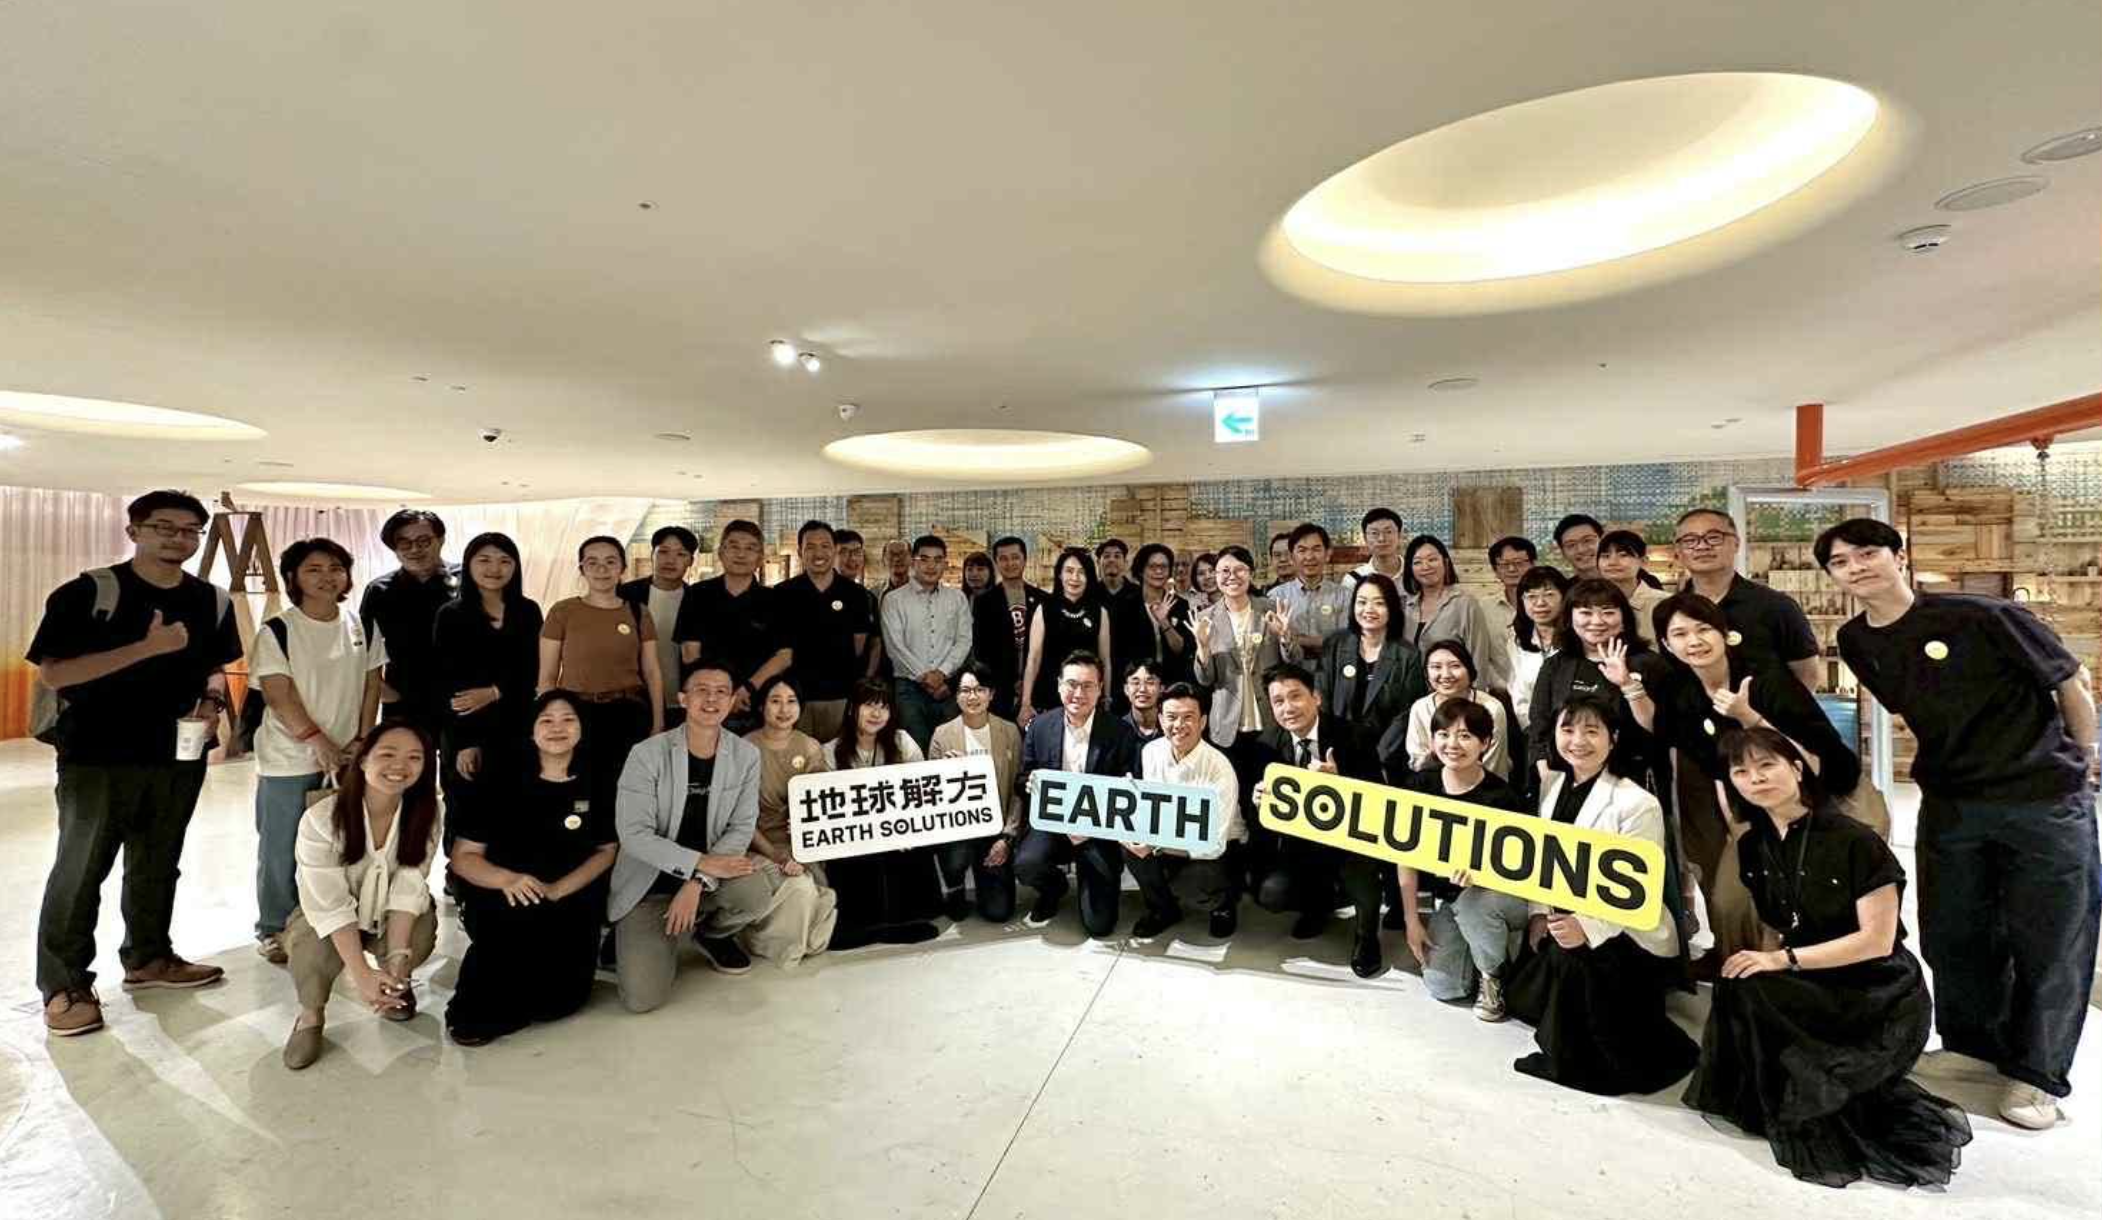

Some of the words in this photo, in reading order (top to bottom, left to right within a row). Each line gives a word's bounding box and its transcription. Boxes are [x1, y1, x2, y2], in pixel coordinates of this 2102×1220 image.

[799, 771, 987, 824] 地球解方
[1038, 779, 1211, 842] EARTH
[802, 823, 873, 849] EARTH
[880, 807, 993, 837] SOLUTIONS
[1269, 775, 1649, 911] SOLUTIONS
